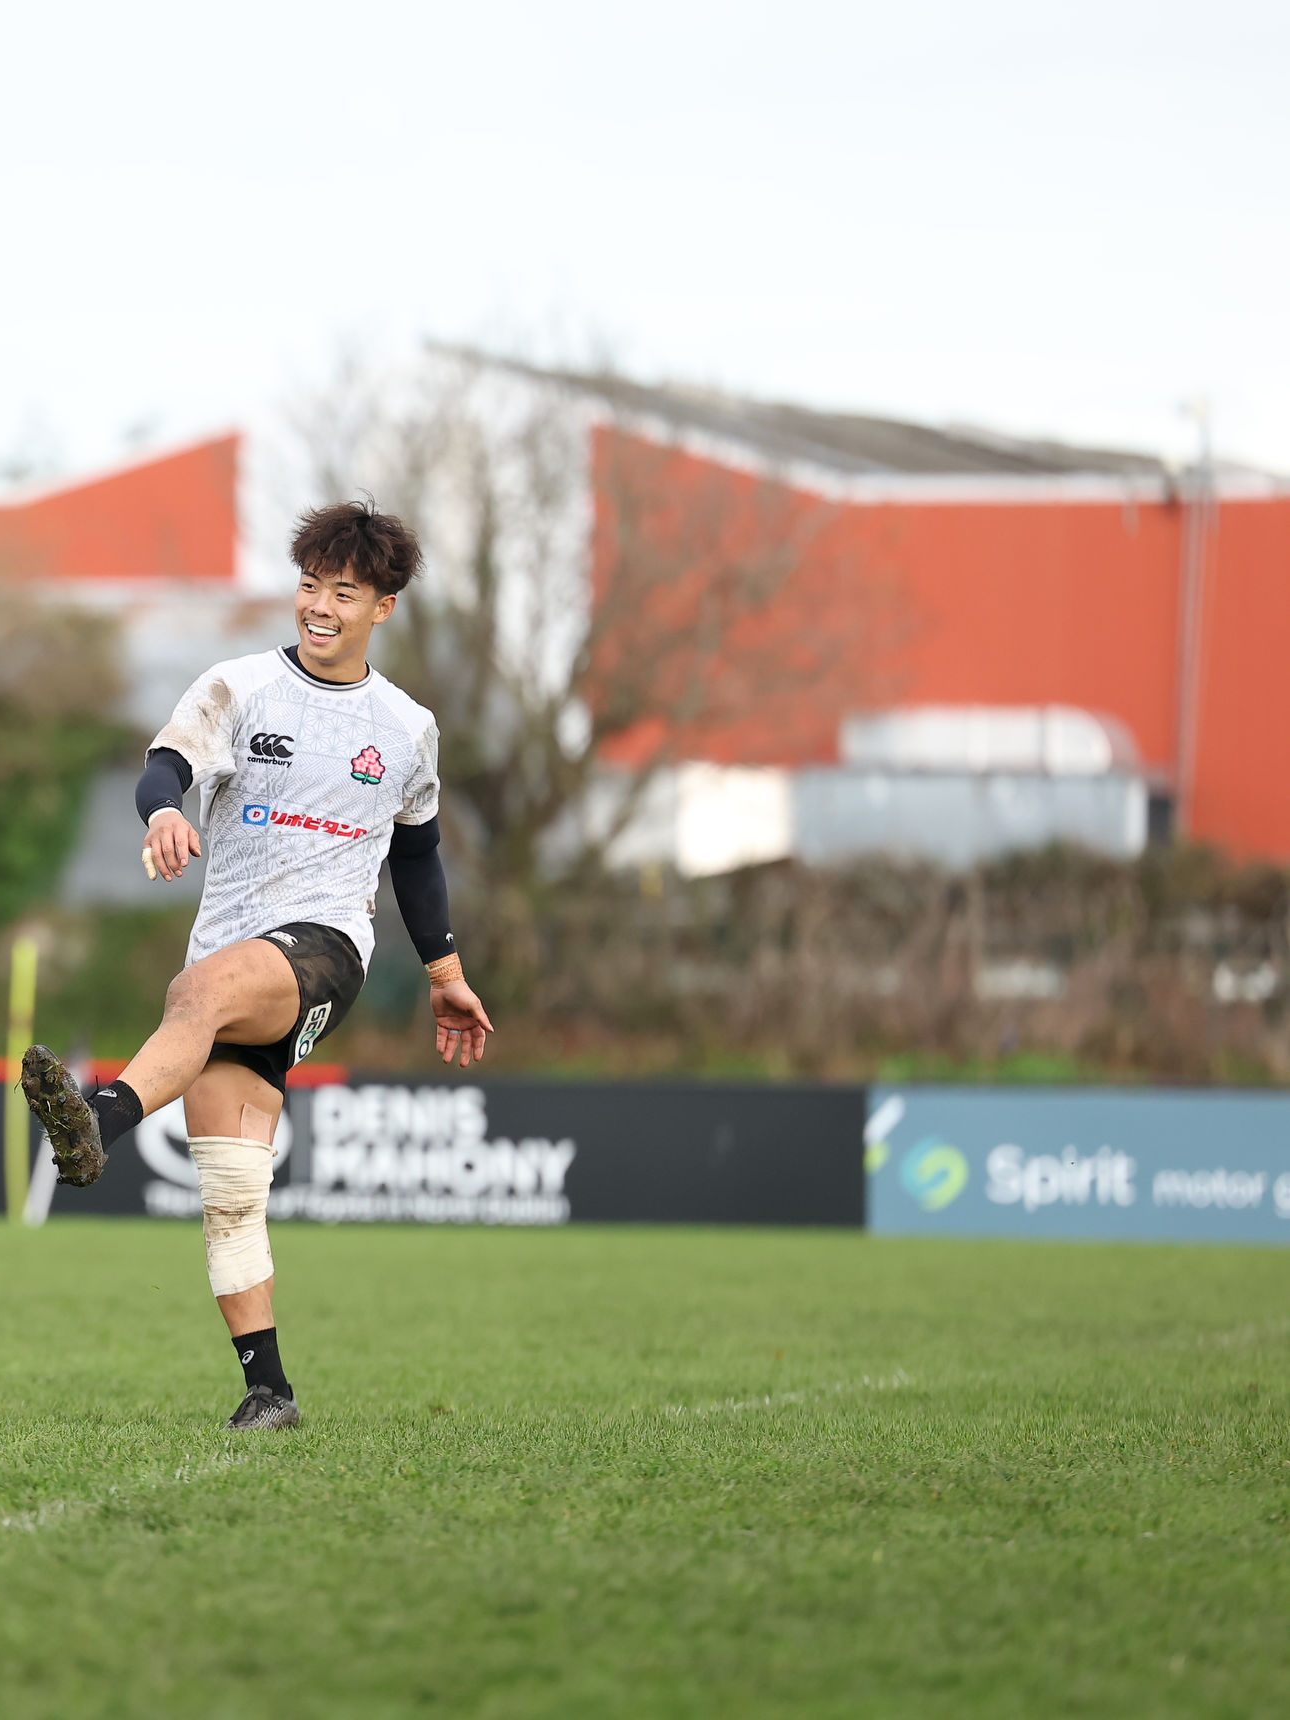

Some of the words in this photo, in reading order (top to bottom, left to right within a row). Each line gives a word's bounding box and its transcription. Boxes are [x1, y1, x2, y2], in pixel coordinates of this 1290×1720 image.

[247, 756, 293, 769] canterbury
[312, 1085, 488, 1141] DENIS
[312, 1137, 576, 1197] MAHONY
[985, 1143, 1137, 1213] Spirit
[1152, 1166, 1268, 1209] motor
